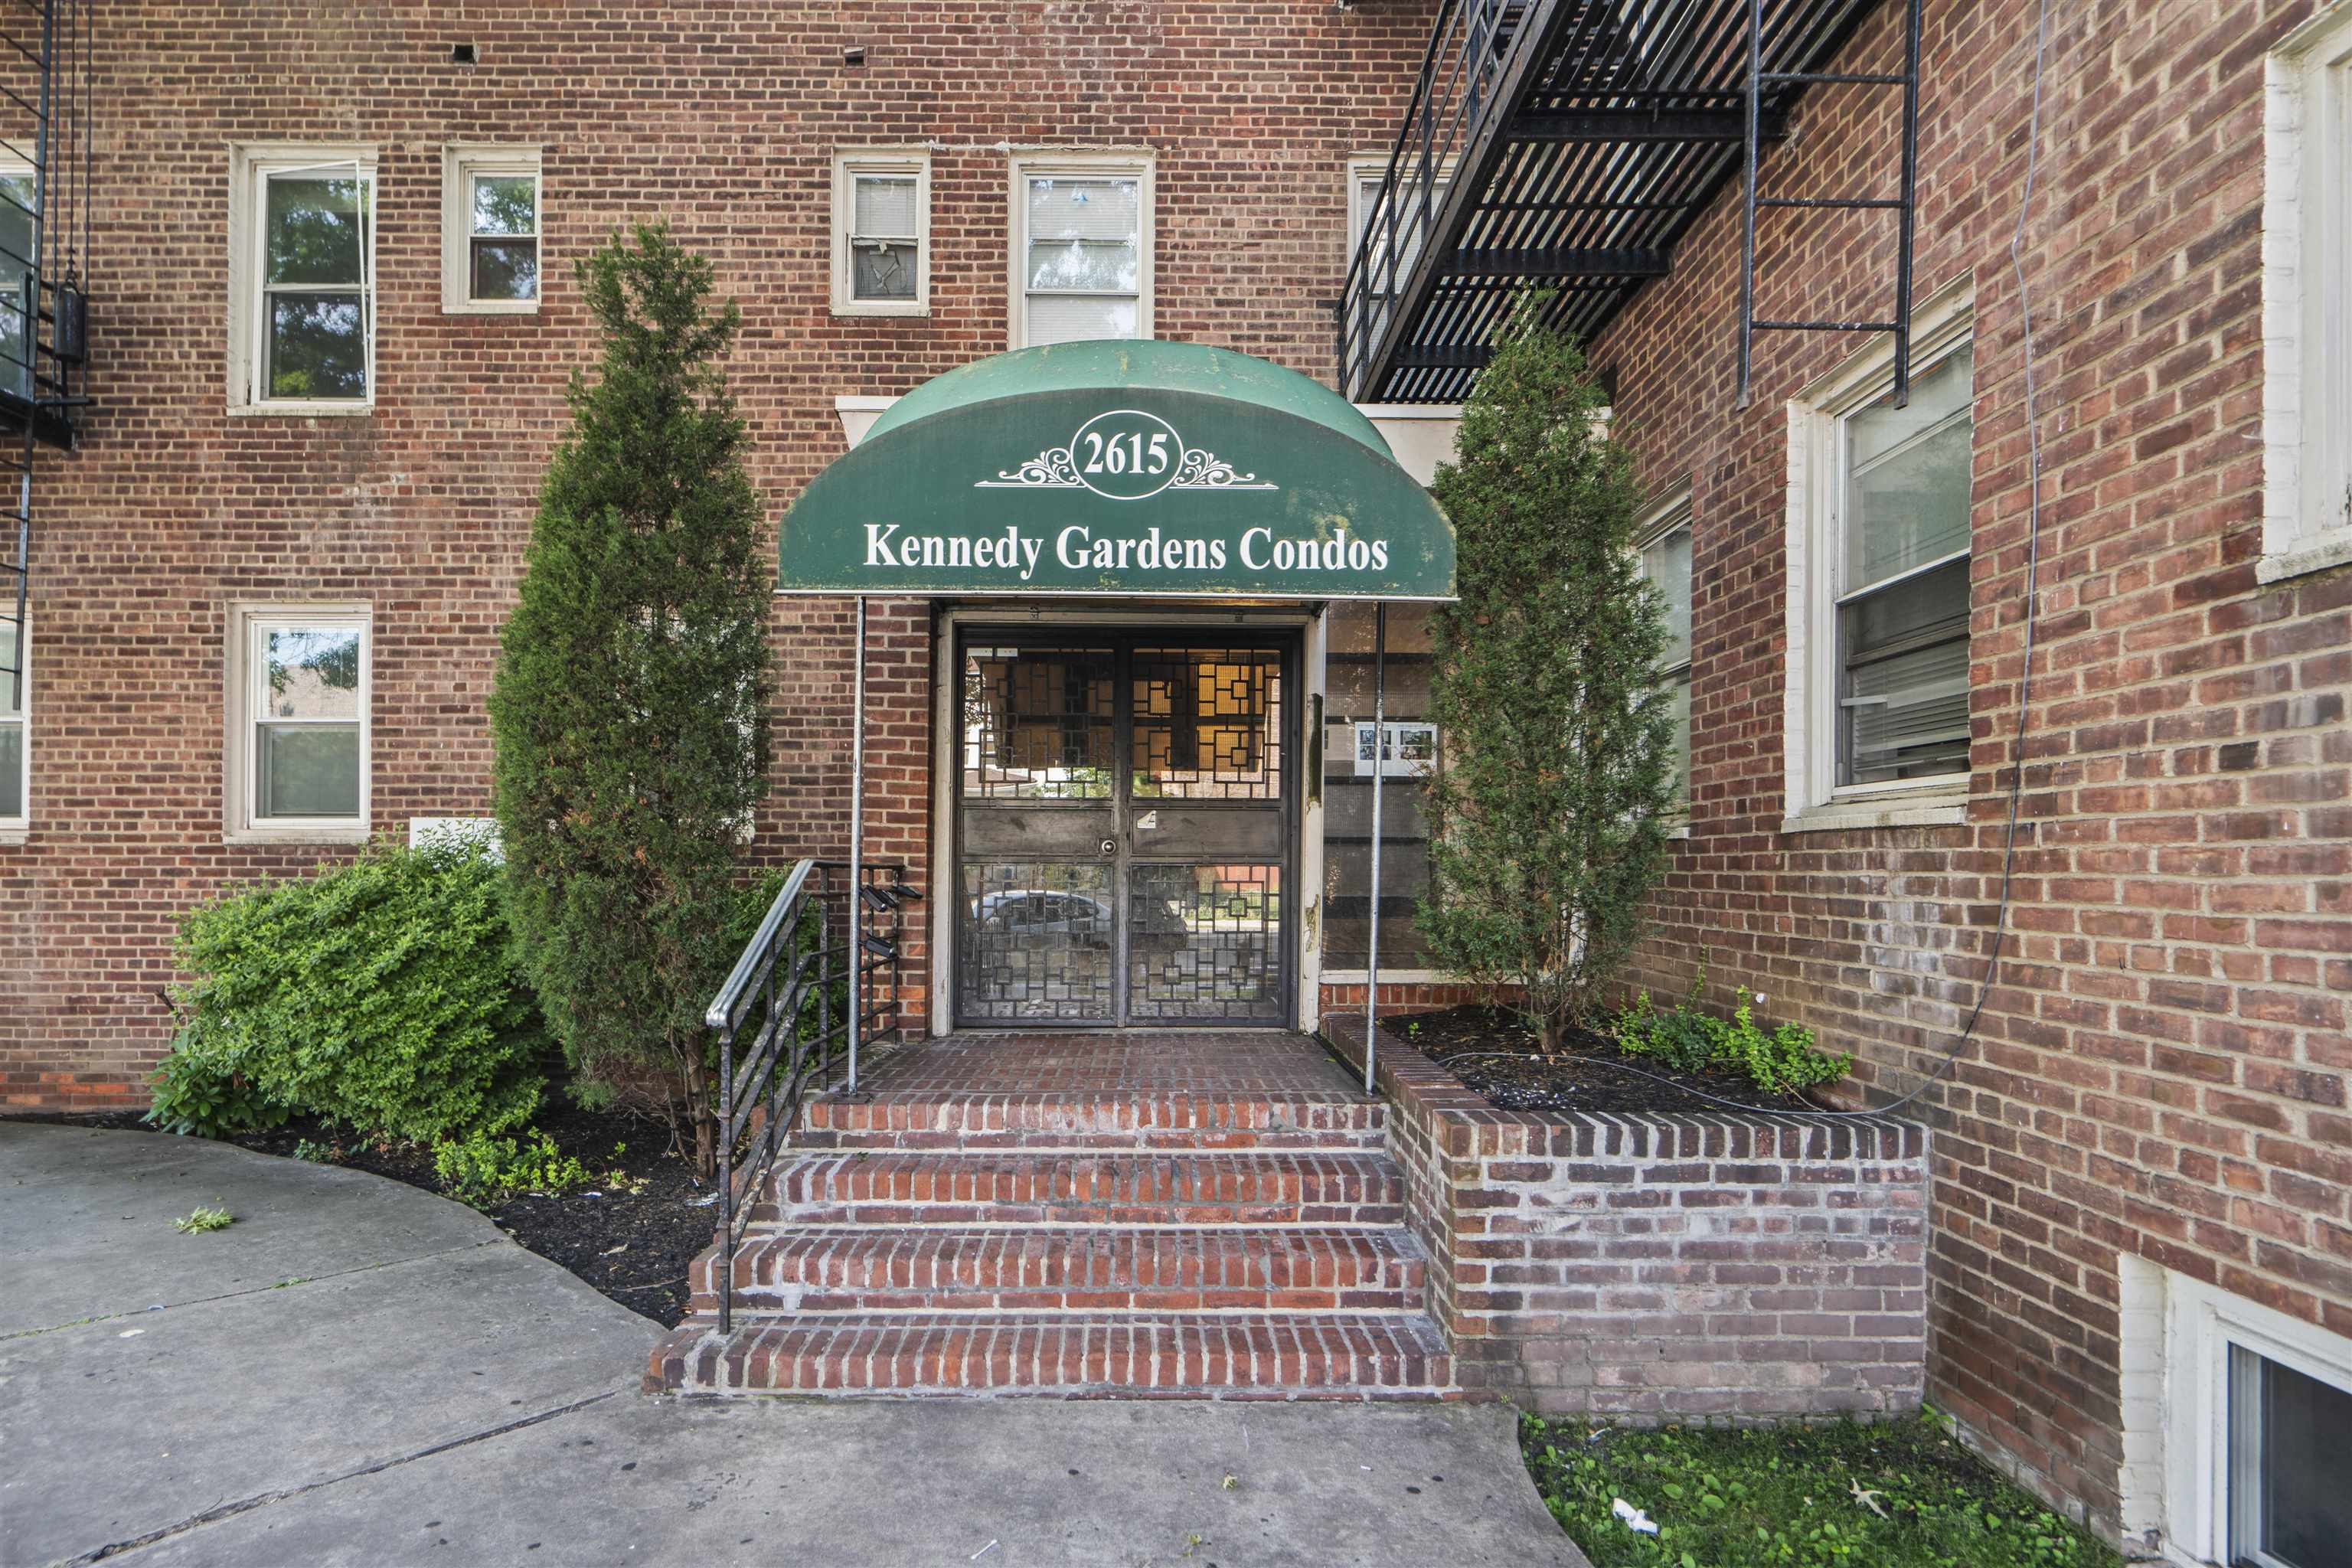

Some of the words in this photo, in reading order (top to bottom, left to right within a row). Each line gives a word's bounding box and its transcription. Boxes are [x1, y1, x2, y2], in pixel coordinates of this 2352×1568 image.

[1083, 431, 1169, 475] 2615
[863, 524, 1044, 580] Kennedy
[1056, 524, 1227, 570] Gardens
[1239, 526, 1389, 571] Condos
